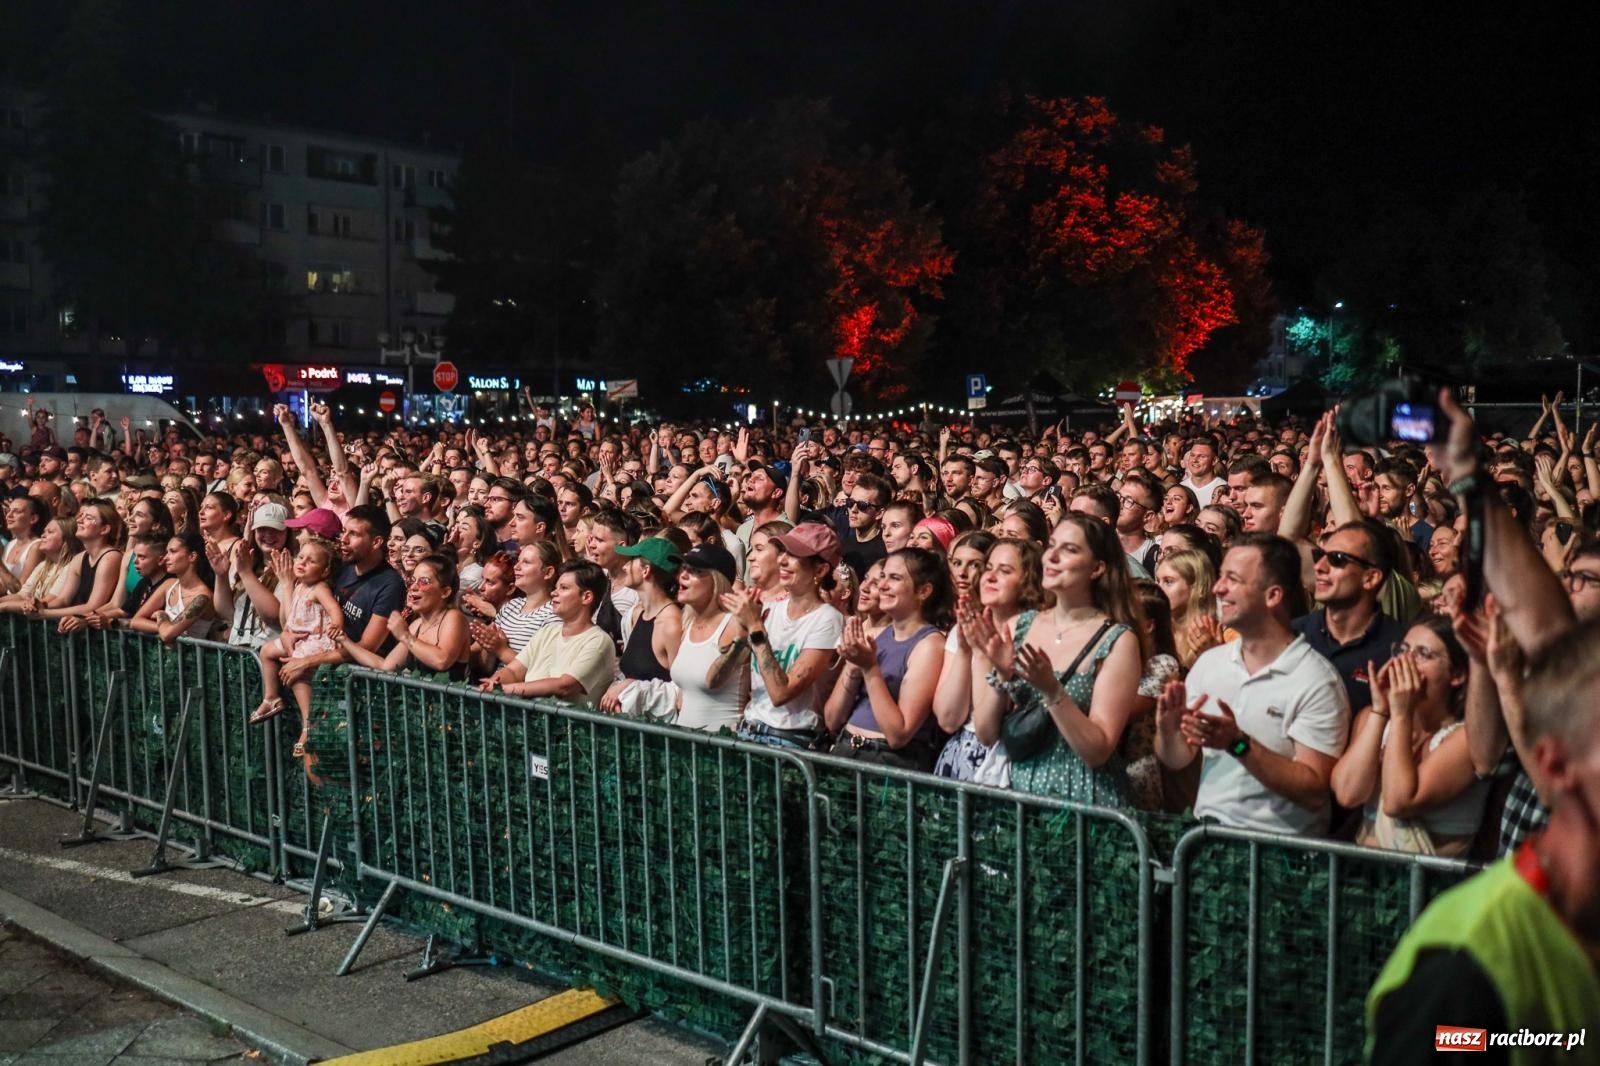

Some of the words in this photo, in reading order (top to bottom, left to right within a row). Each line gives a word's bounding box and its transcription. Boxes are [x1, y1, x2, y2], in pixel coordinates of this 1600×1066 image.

[436, 371, 456, 382] STOP
[469, 376, 499, 389] SALON
[971, 378, 982, 395] P
